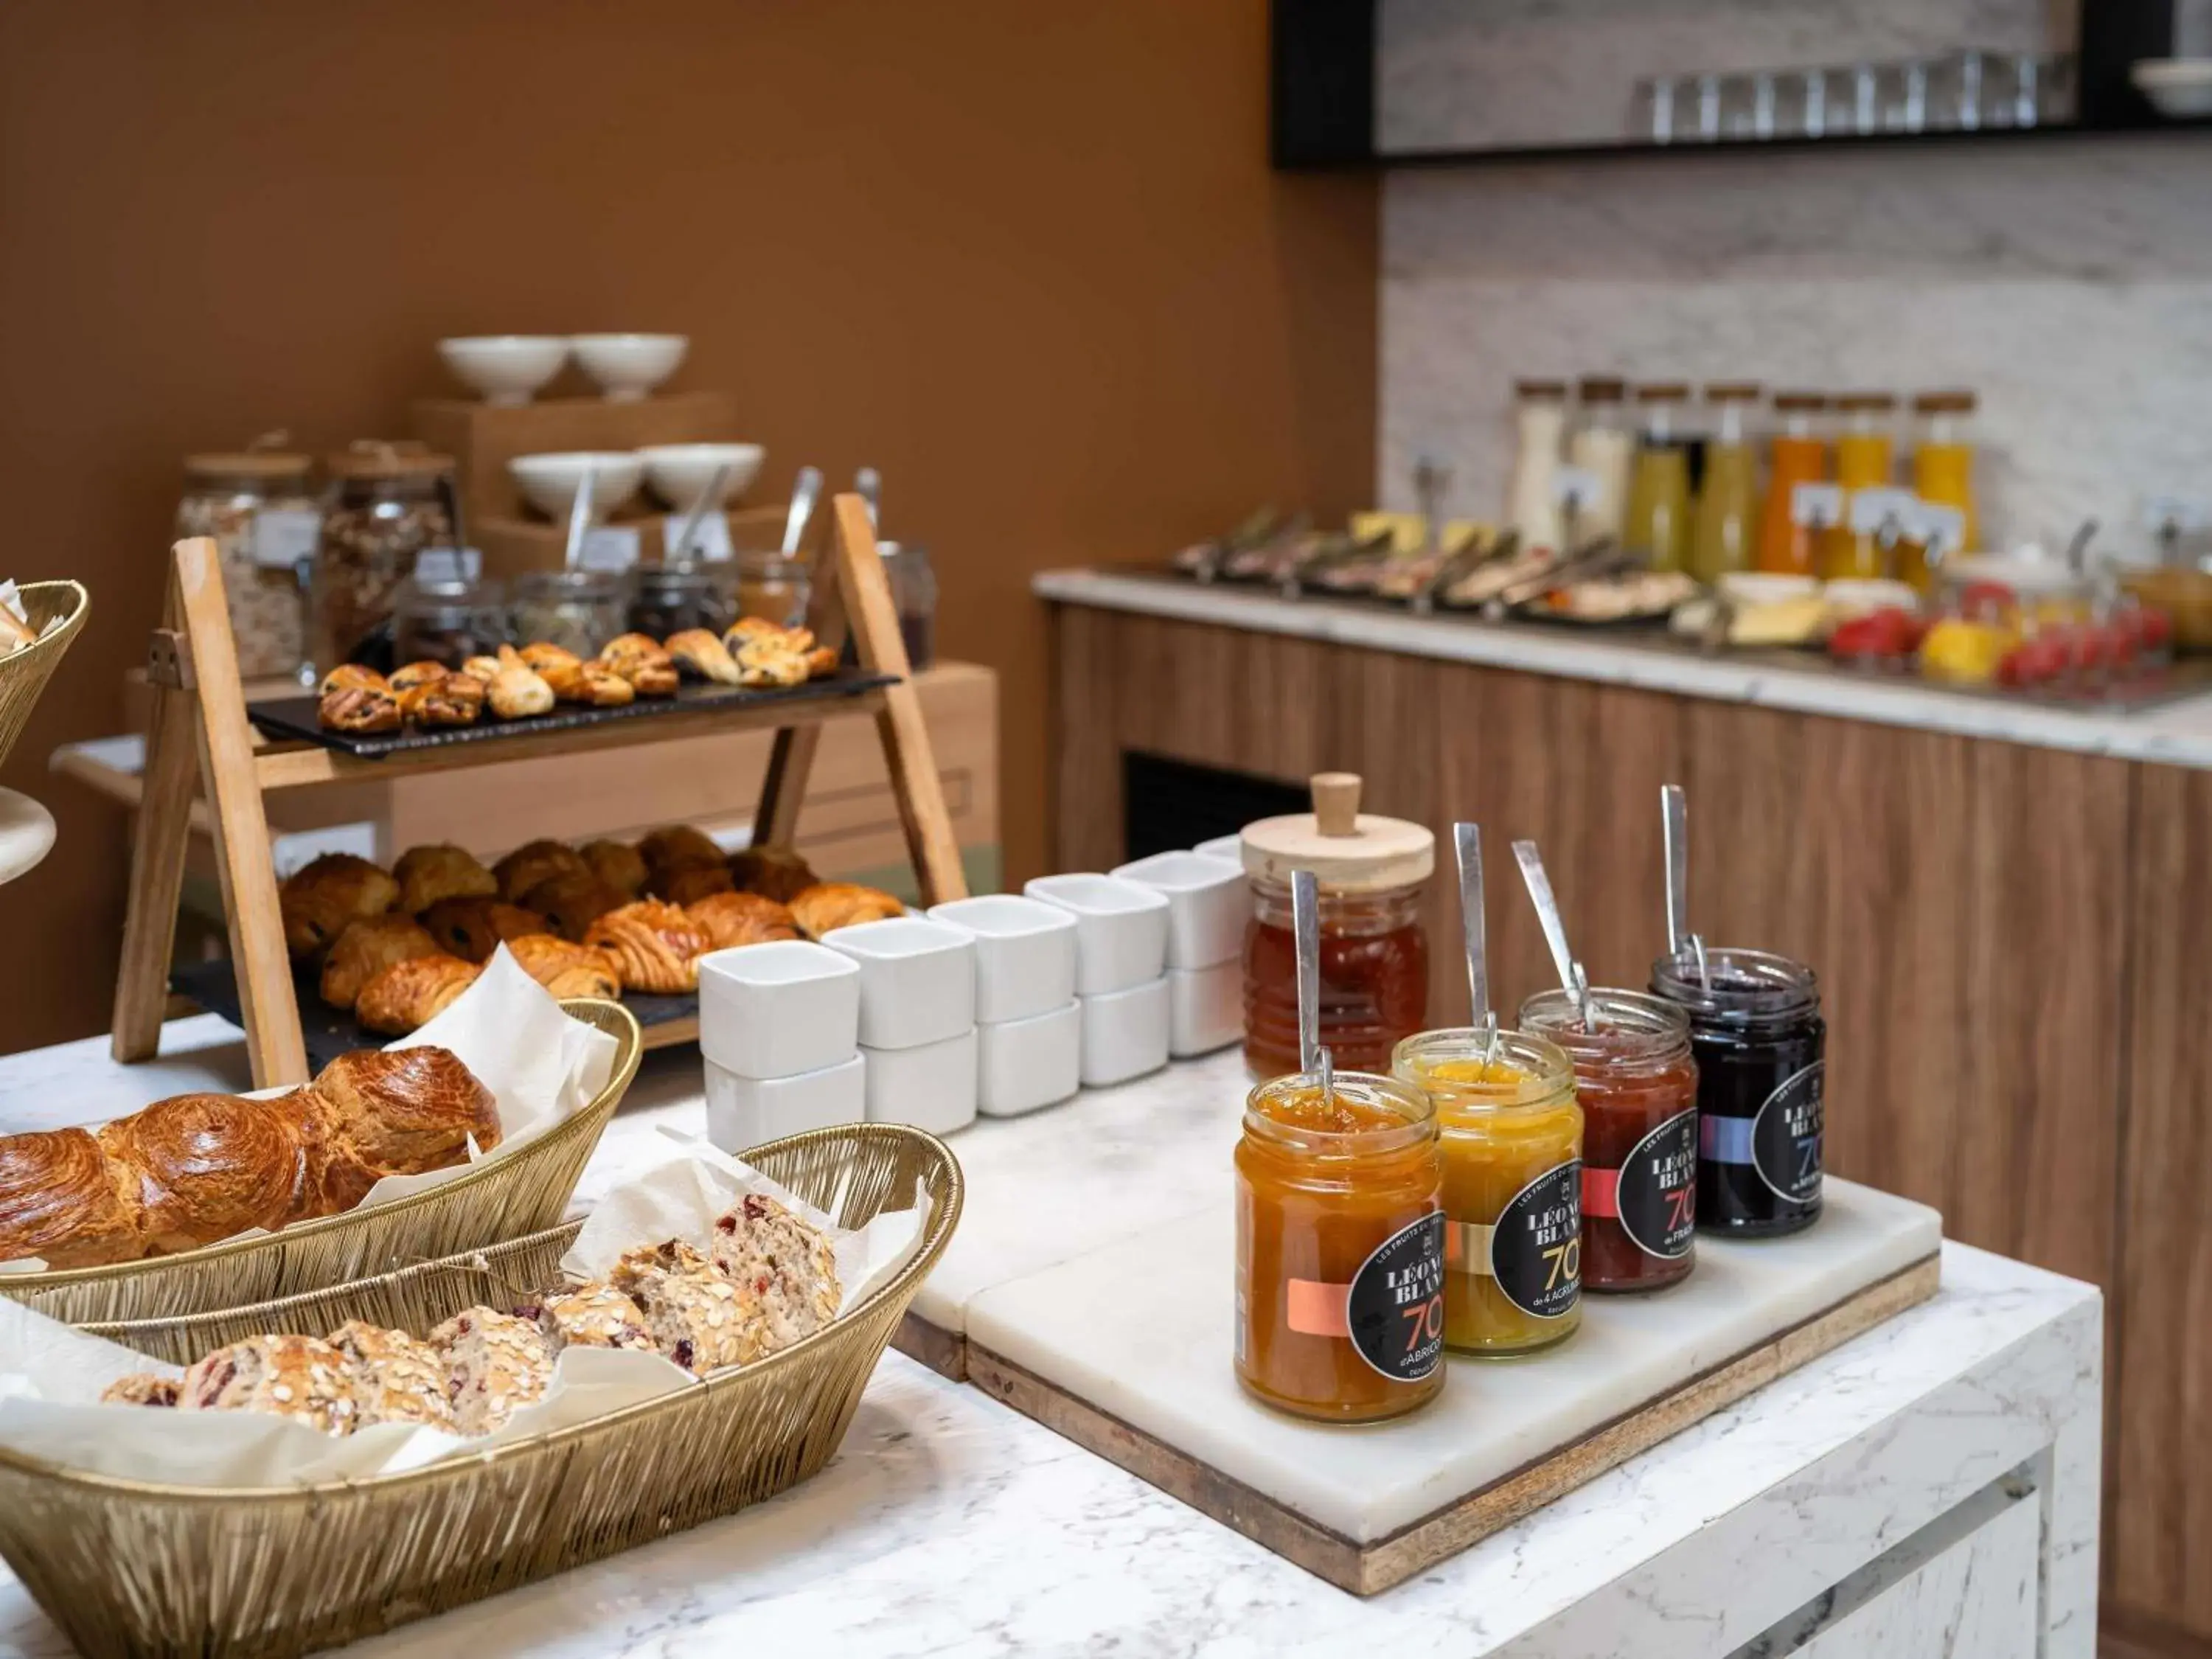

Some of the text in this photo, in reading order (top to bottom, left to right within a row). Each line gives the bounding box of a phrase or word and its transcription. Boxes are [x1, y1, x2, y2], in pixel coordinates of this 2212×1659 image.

[1664, 1183, 1695, 1231] 70
[1376, 1228, 1418, 1264] LES FRUITS
[1543, 1238, 1579, 1290] 70
[1402, 1294, 1442, 1352] 70
[1533, 1298, 1543, 1306] de
[1544, 1293, 1551, 1303] 4
